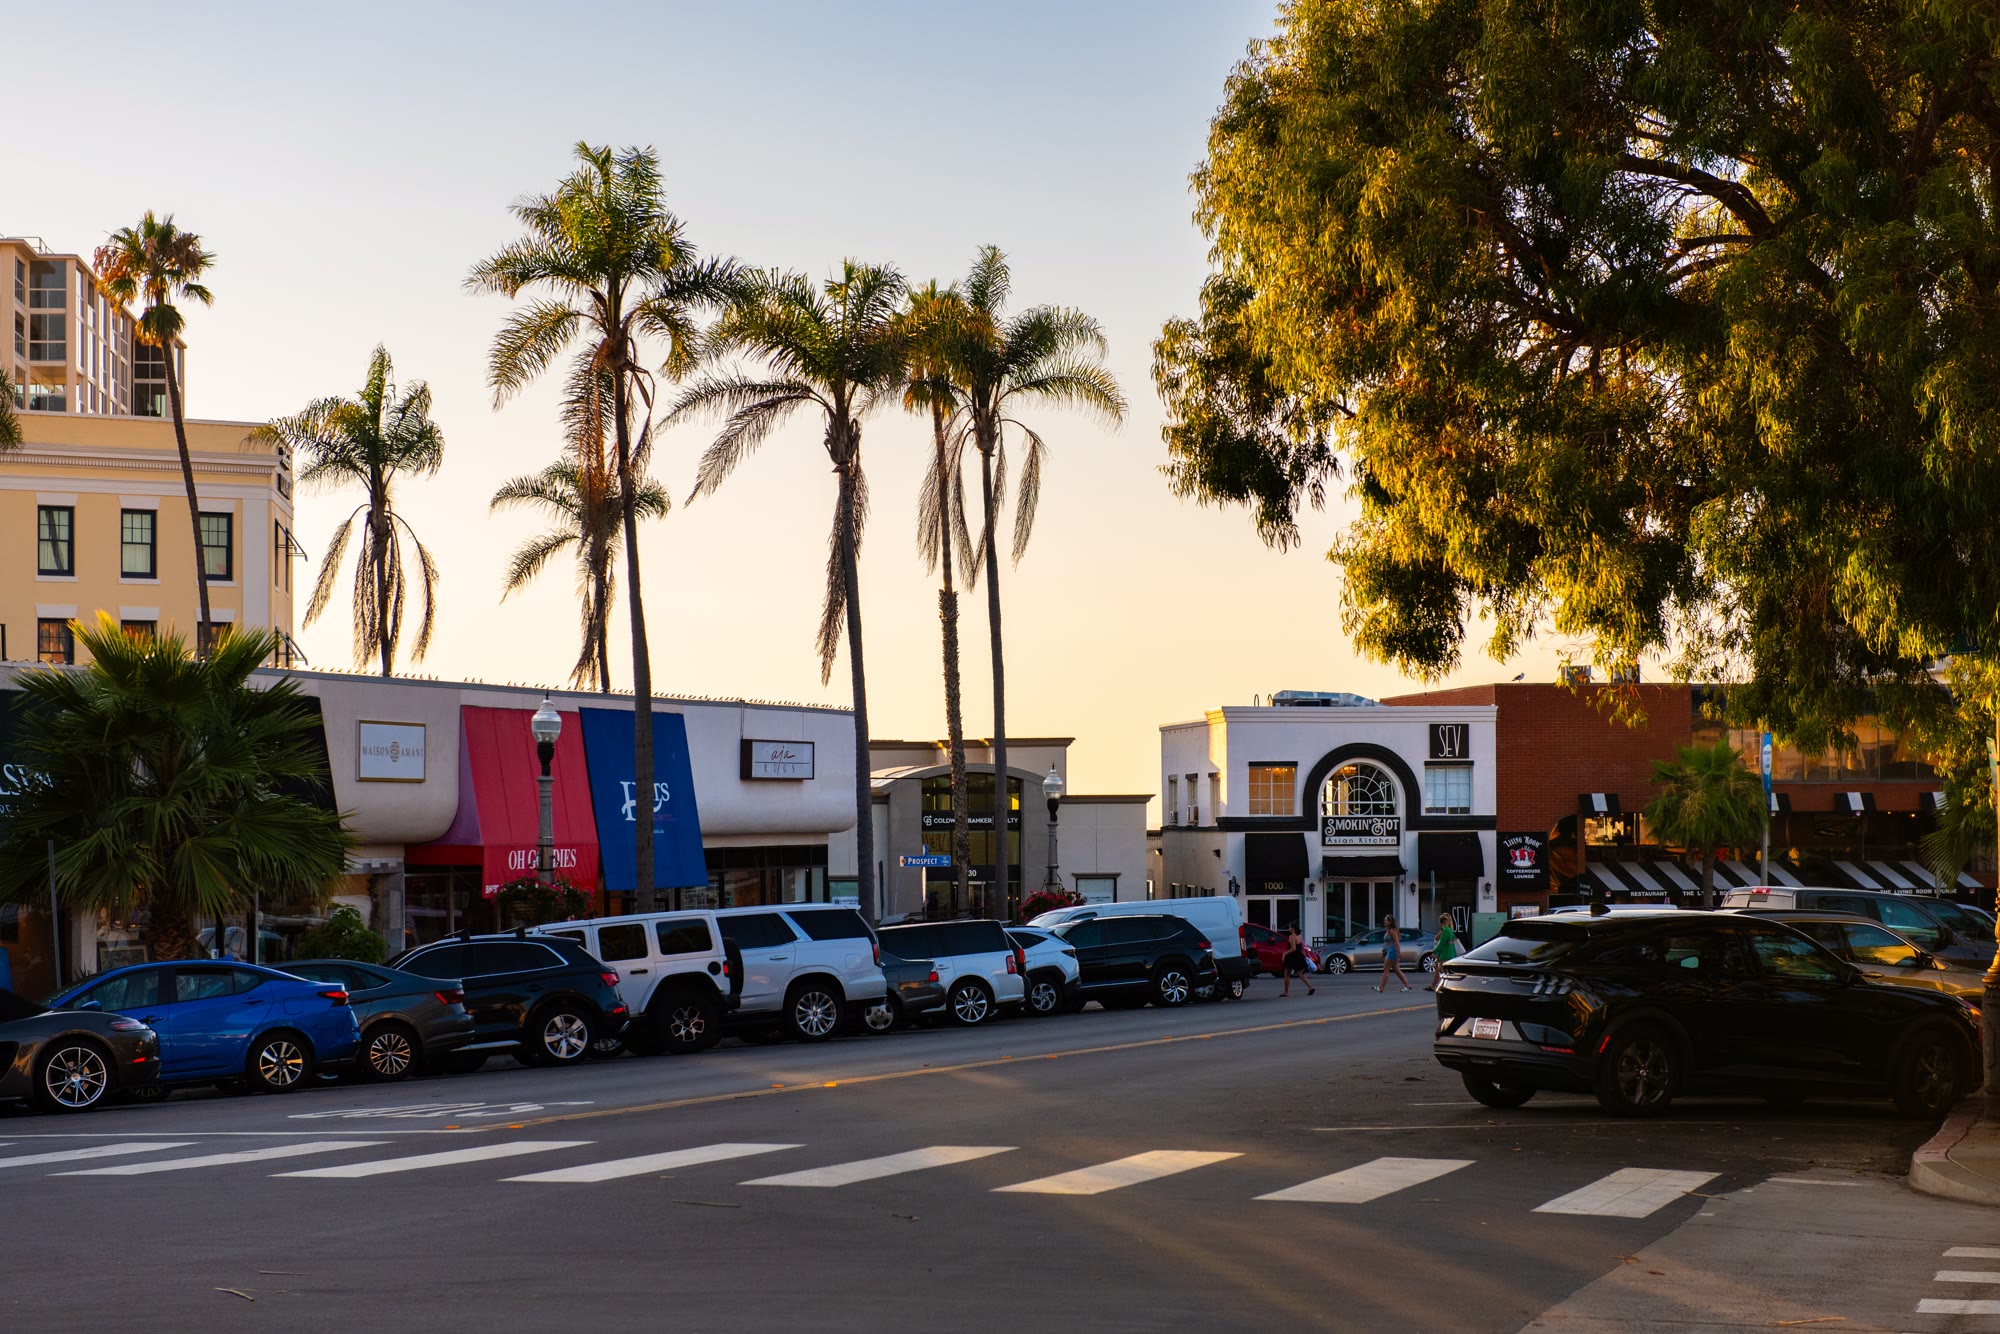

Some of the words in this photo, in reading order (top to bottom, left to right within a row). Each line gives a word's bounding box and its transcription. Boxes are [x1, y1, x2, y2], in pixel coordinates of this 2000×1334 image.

[1438, 725, 1461, 757] SEV
[362, 746, 390, 756] MAISON
[400, 747, 424, 758] AMANI
[763, 763, 795, 773] RUGS
[1325, 818, 1372, 836] SMOKIN'
[1371, 818, 1399, 836] HOT
[508, 850, 526, 870] OH
[527, 848, 577, 869] GDIES
[907, 857, 938, 865] PROSPECT
[1264, 882, 1284, 890] 1000
[1451, 906, 1470, 933] SEV
